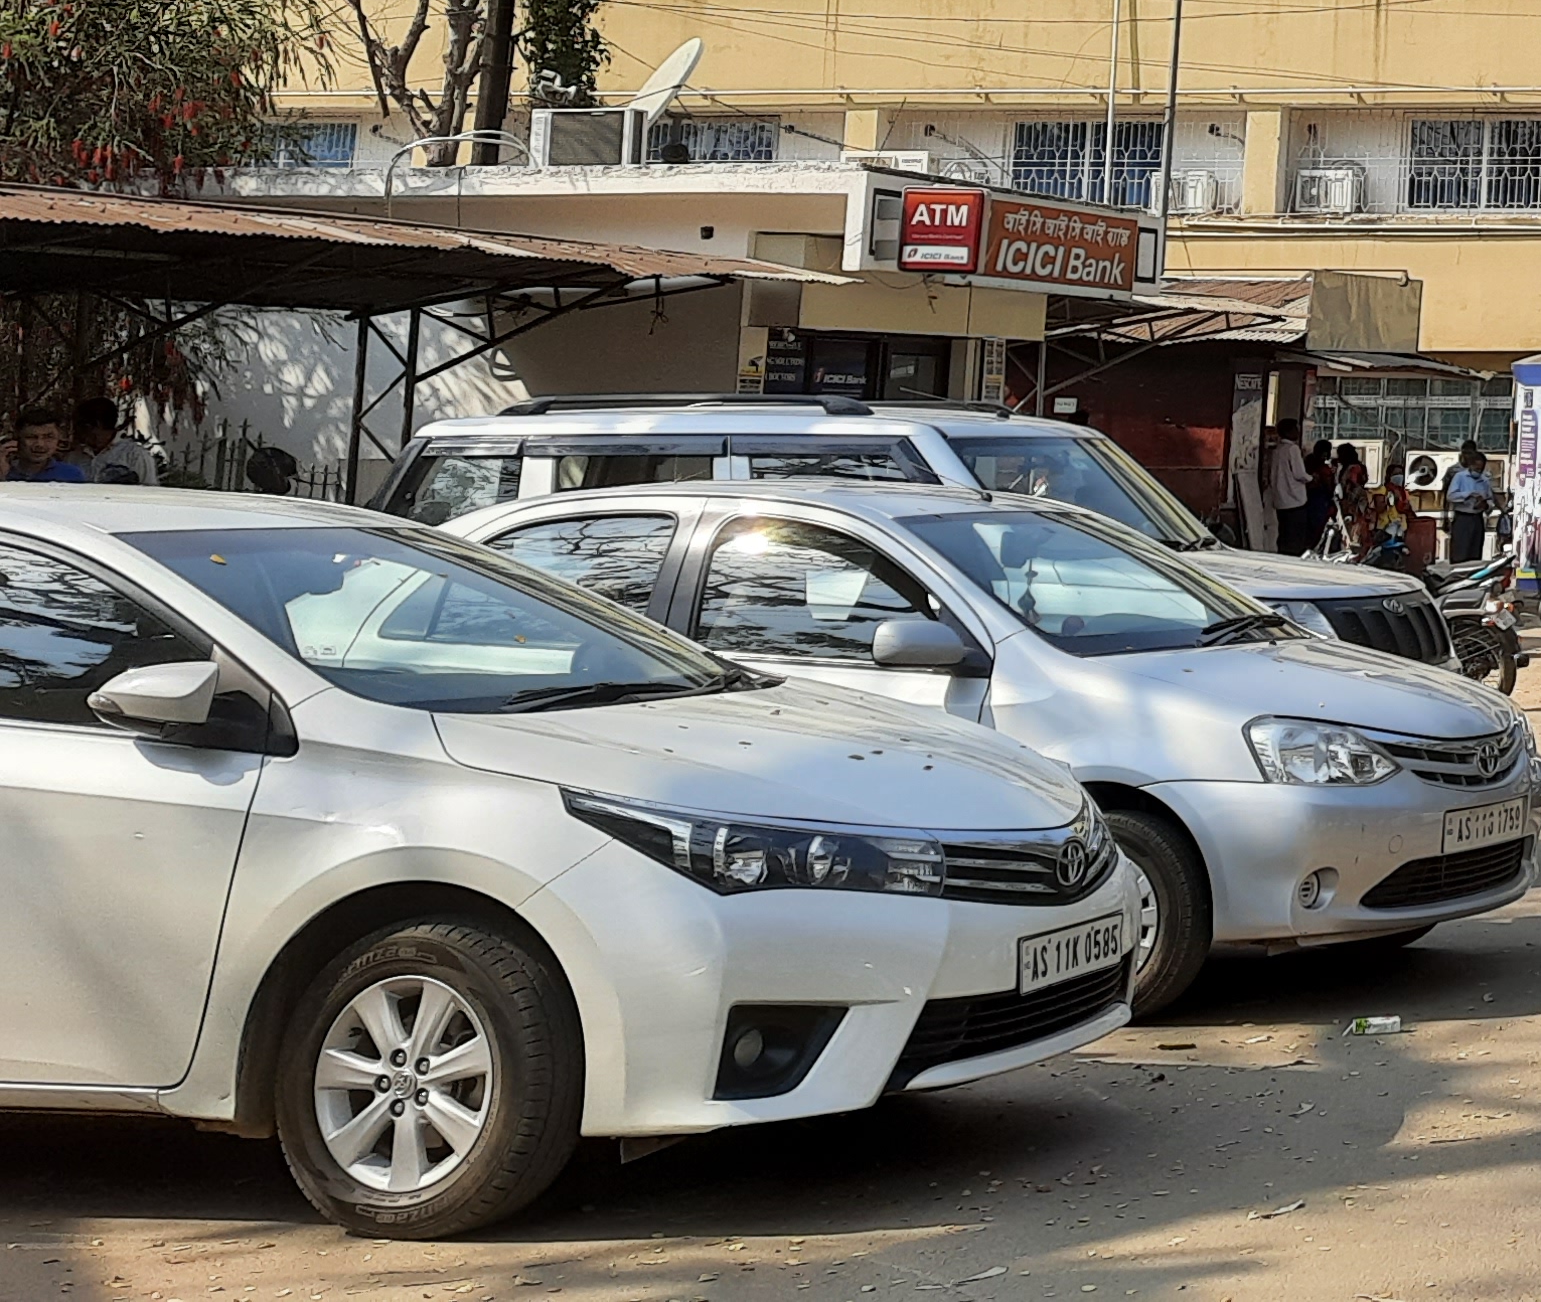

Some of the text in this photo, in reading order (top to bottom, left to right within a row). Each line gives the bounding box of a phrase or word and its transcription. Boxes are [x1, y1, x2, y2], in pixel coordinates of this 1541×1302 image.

[910, 203, 969, 227] ATM
[920, 252, 942, 260] ICICI
[995, 238, 1126, 286] ICICI Bank
[823, 373, 867, 385] ICICI Bank
[1457, 816, 1472, 843] AS
[1498, 805, 1520, 834] 1759
[1031, 923, 1119, 982] AS 11K 0585
